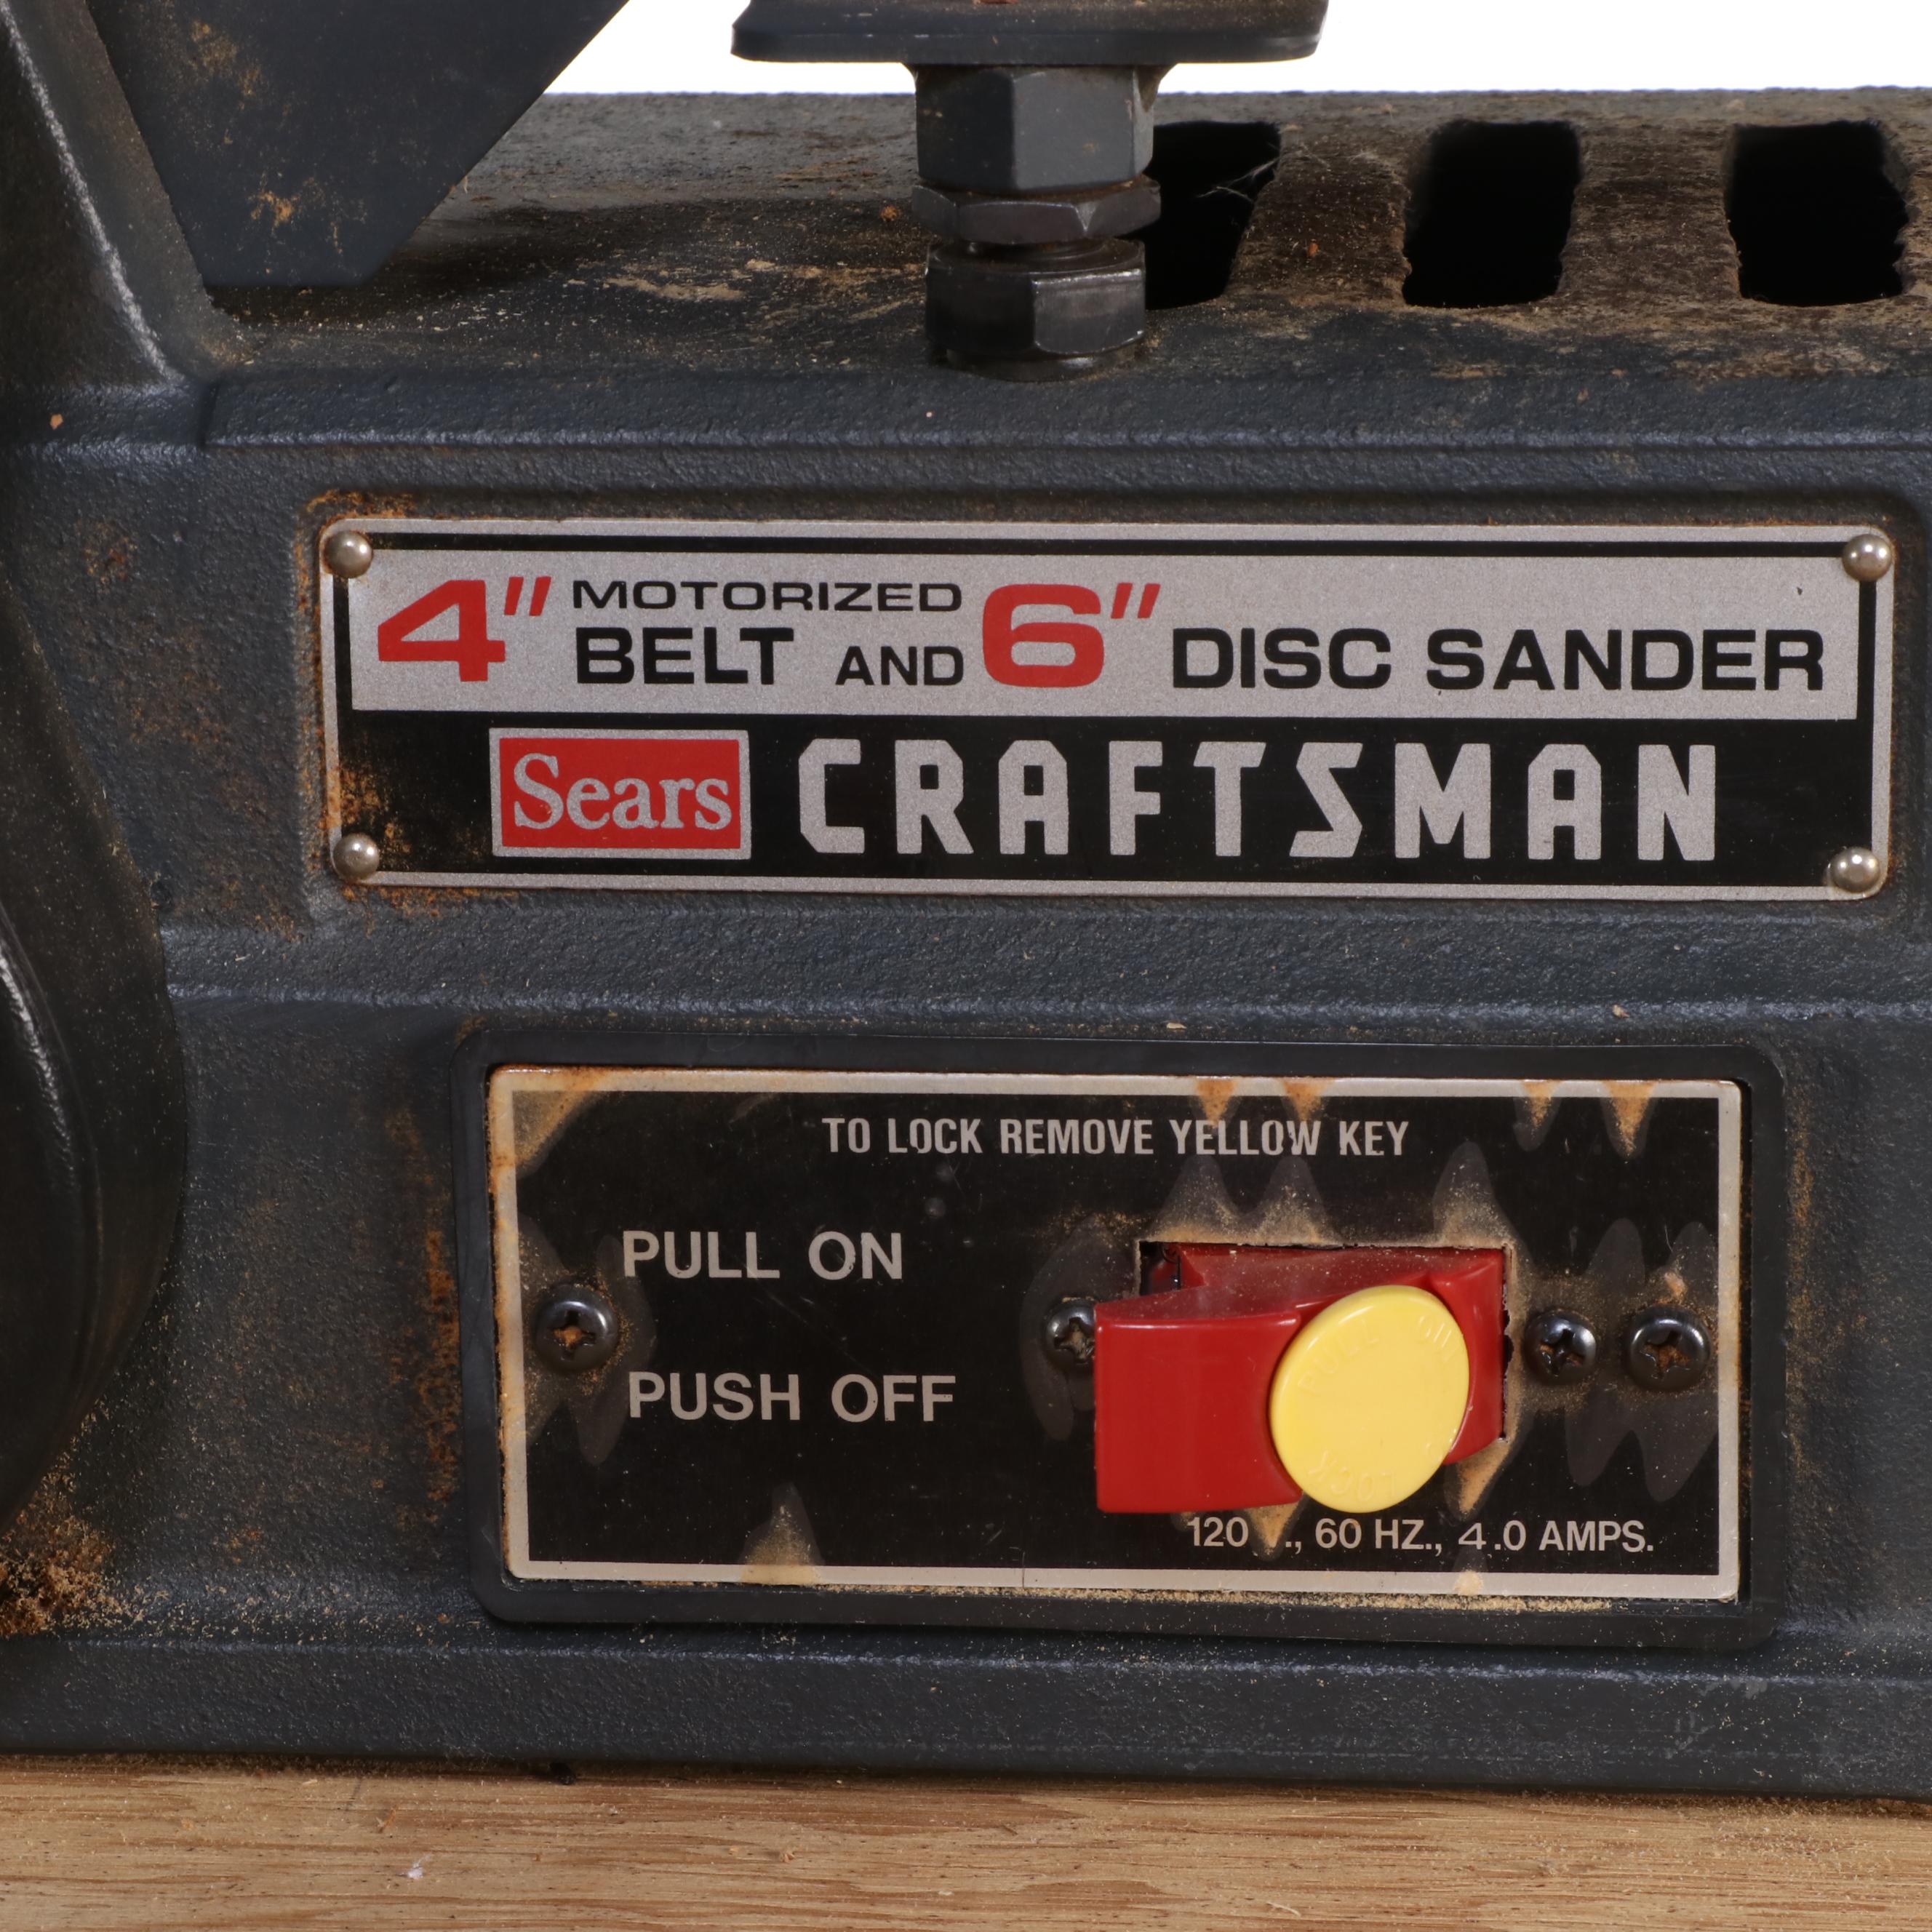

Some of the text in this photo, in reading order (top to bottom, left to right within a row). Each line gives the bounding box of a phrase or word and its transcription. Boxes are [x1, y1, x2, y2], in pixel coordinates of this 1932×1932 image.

[573, 580, 962, 612] MOTORIZED
[378, 576, 551, 682] 4"
[576, 627, 963, 686] BELT AND
[983, 583, 1160, 687] 6"
[1173, 628, 1823, 690] DISC SANDER
[514, 754, 732, 830] Sears
[799, 739, 1715, 861] CRAFTSMAN
[822, 1118, 1408, 1155] TO LOCK REMOVE YELLOW KEY
[624, 1232, 901, 1280] PULL ON
[630, 1373, 955, 1421] PUSH OFF
[1188, 1517, 1248, 1546] 120
[1316, 1519, 1361, 1548] 60
[1376, 1520, 1442, 1556] HZ.,
[1458, 1520, 1525, 1550] 4.0
[1539, 1520, 1653, 1552] AMPS.
